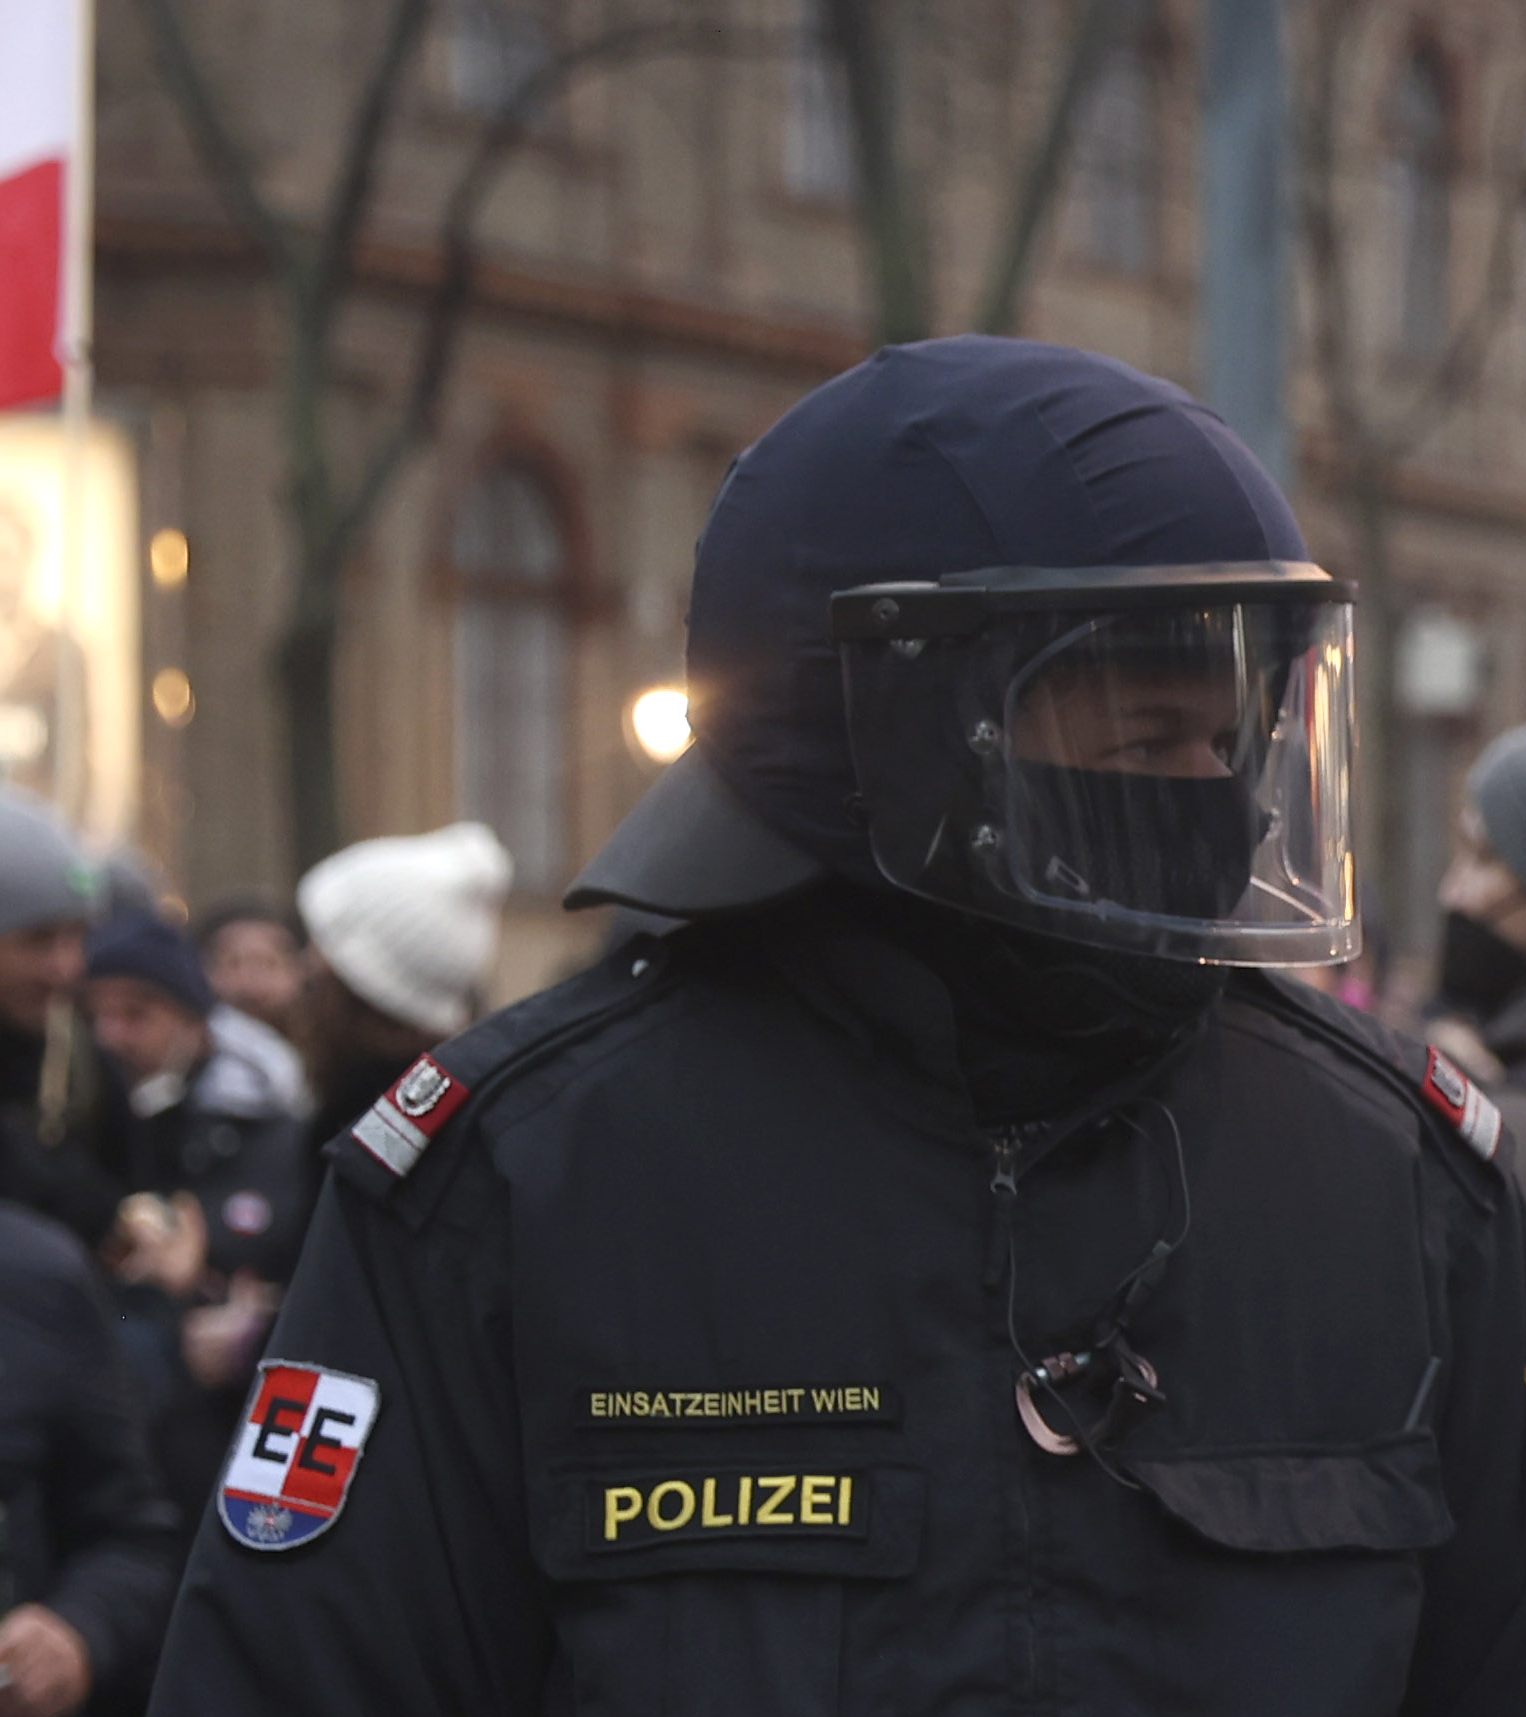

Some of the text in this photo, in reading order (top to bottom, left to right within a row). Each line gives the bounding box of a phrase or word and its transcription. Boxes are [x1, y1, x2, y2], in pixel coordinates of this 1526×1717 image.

[590, 1387, 881, 1418] EINSATZEINHEIT WIEN
[253, 1396, 356, 1477] EE
[603, 1474, 853, 1541] POLIZEI
